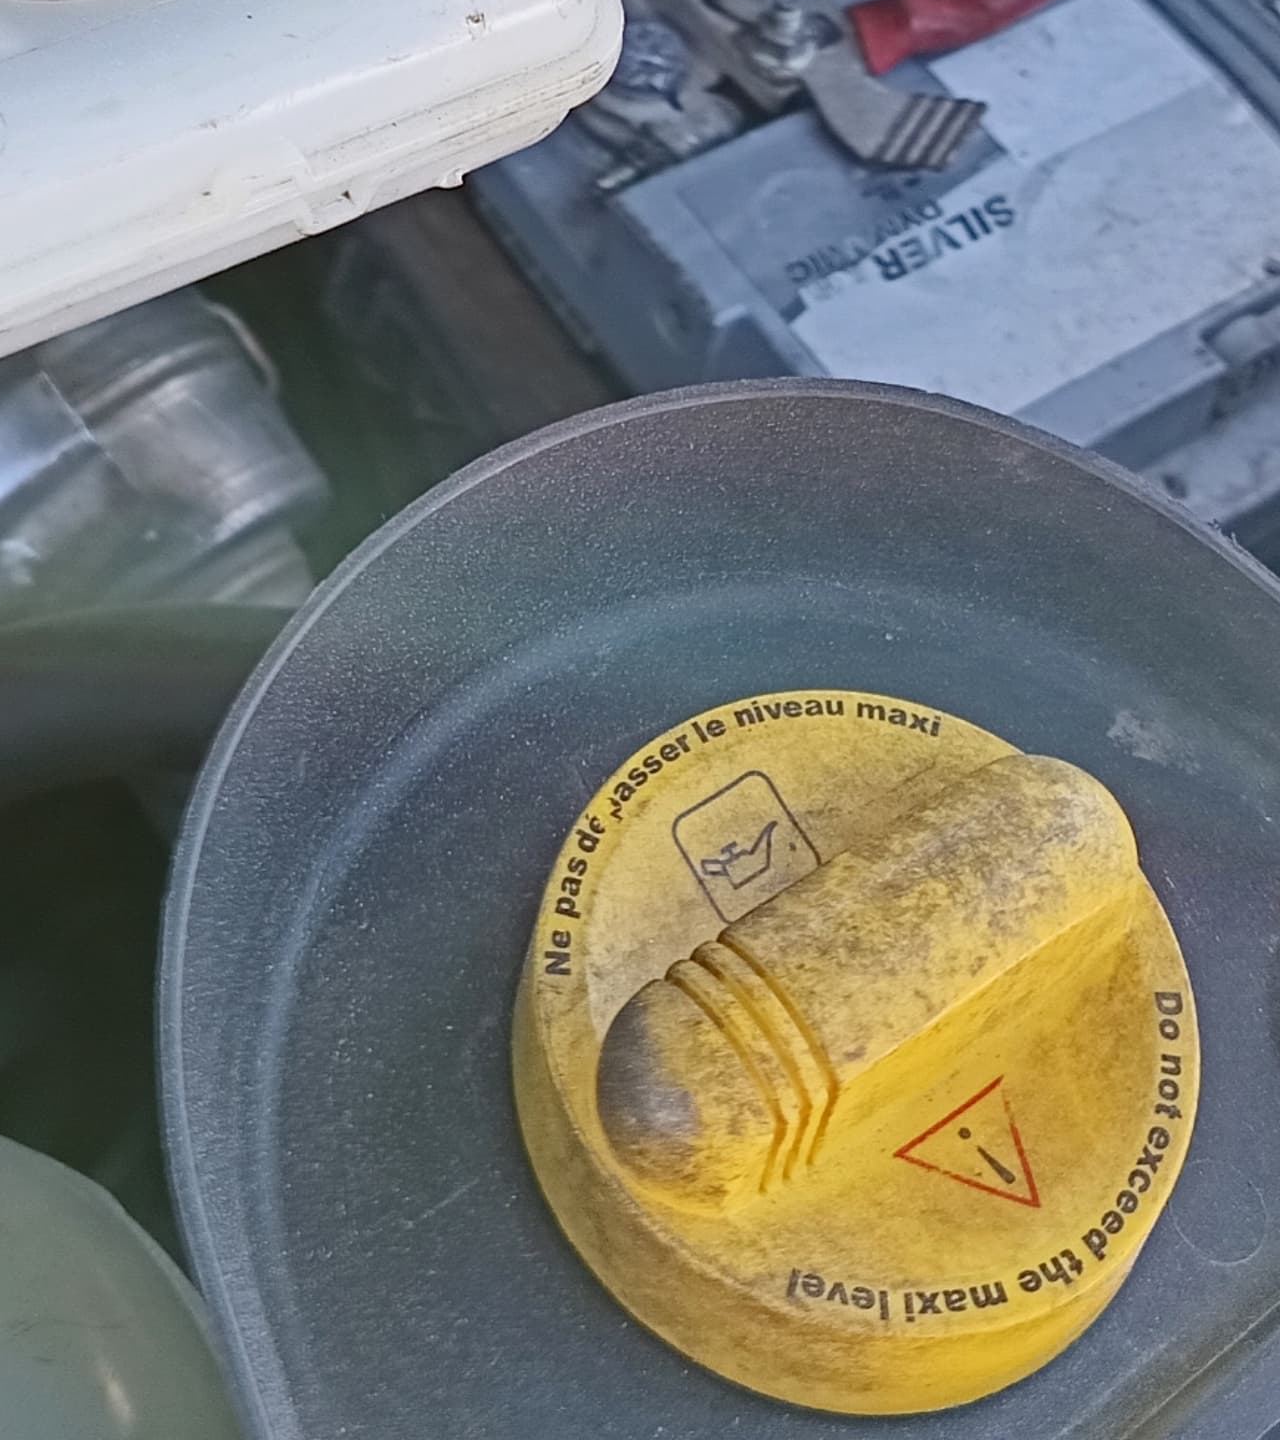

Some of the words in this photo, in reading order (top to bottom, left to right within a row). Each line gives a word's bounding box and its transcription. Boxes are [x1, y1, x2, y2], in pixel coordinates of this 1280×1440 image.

[788, 198, 946, 285] DYNIC
[872, 194, 1018, 283] SILVER
[691, 718, 728, 744] le
[734, 699, 844, 728] niveau
[857, 701, 942, 737] maxi
[554, 855, 588, 920] pas
[545, 929, 572, 976] Ne
[1155, 991, 1184, 1041] Do
[1154, 1054, 1183, 1120] not
[1081, 1126, 1171, 1262] exceed
[785, 1268, 890, 1322] level
[1017, 1248, 1084, 1293] the
[904, 1280, 1009, 1323] maxi
